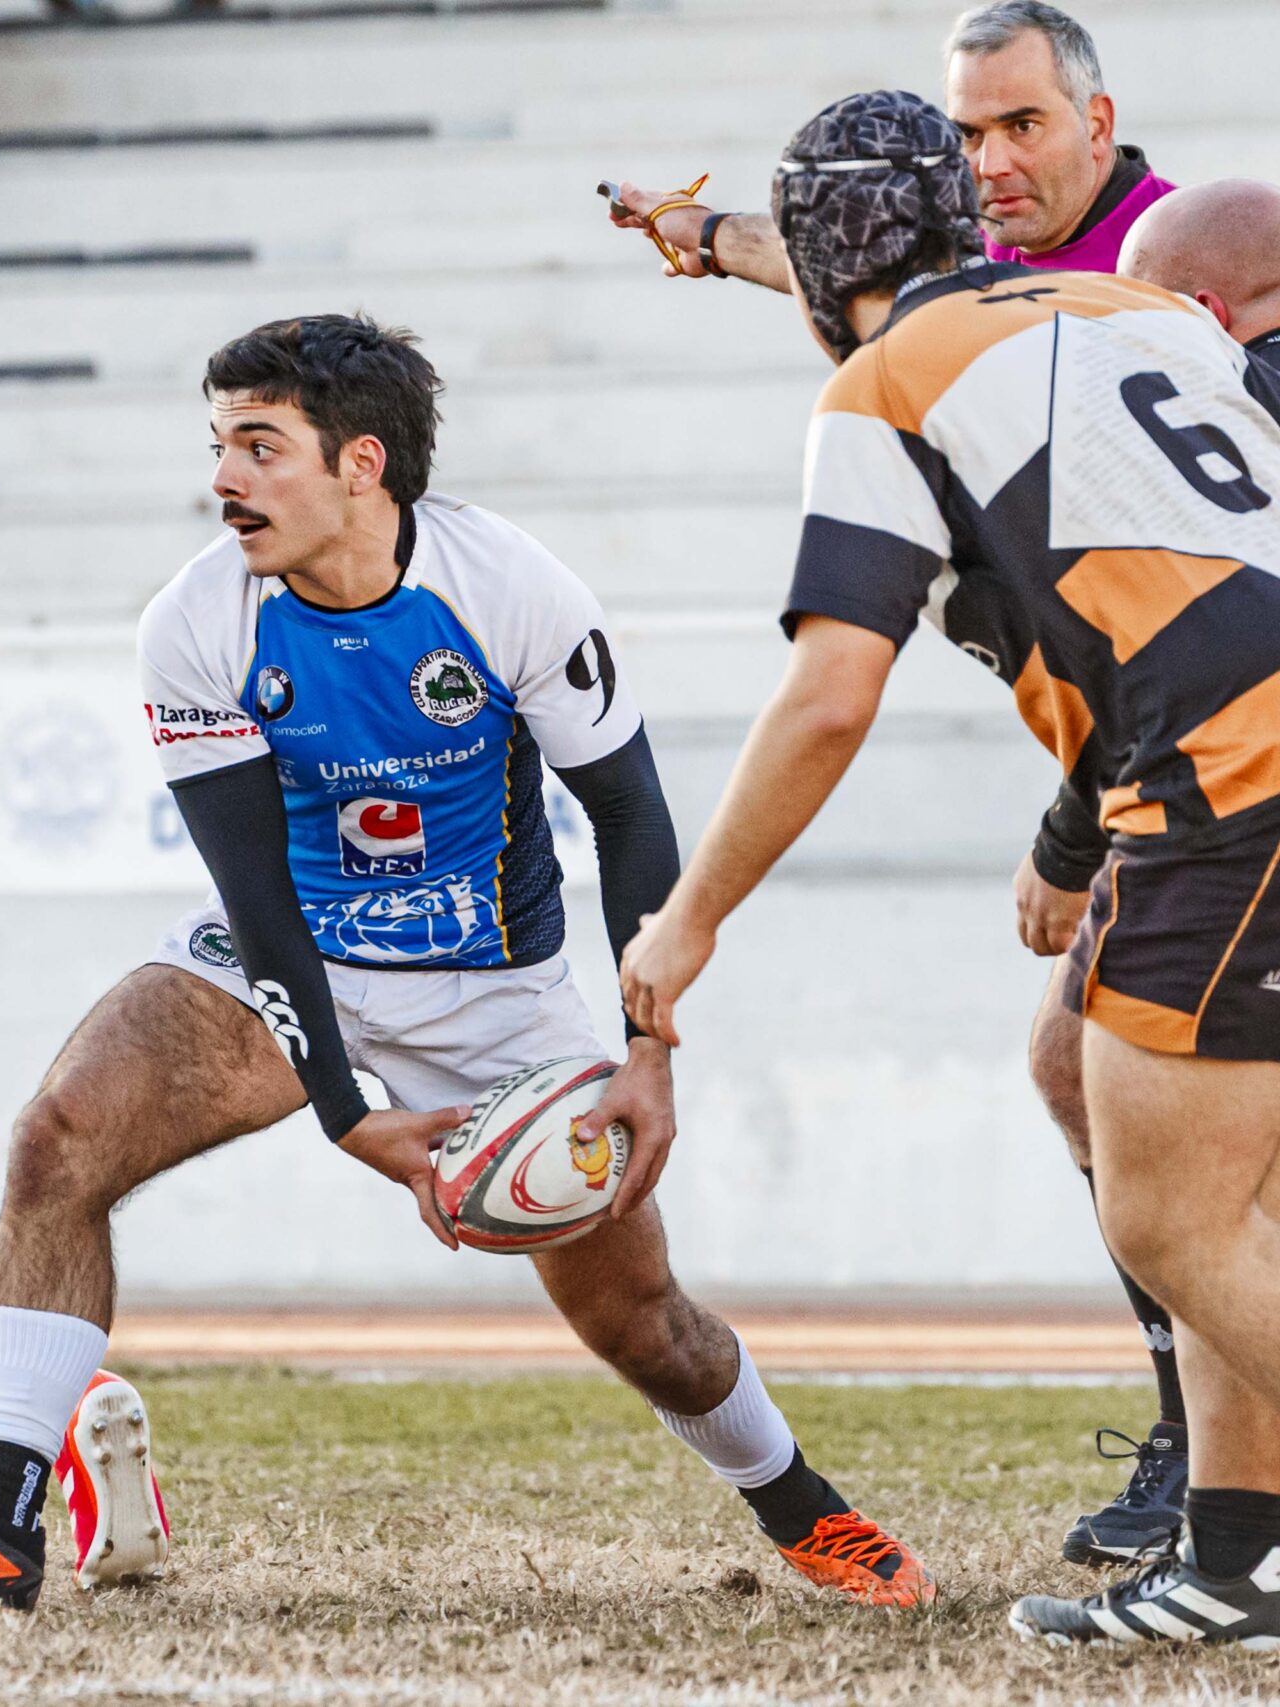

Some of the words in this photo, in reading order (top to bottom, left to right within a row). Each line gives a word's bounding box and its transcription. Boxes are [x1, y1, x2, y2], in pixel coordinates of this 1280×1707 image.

[1119, 371, 1272, 514] 6
[565, 628, 616, 727] 9
[429, 695, 477, 712] RUGBY
[431, 706, 480, 724] ZARAGOZA
[319, 737, 486, 781] Universidad
[610, 1122, 627, 1177] RUGB
